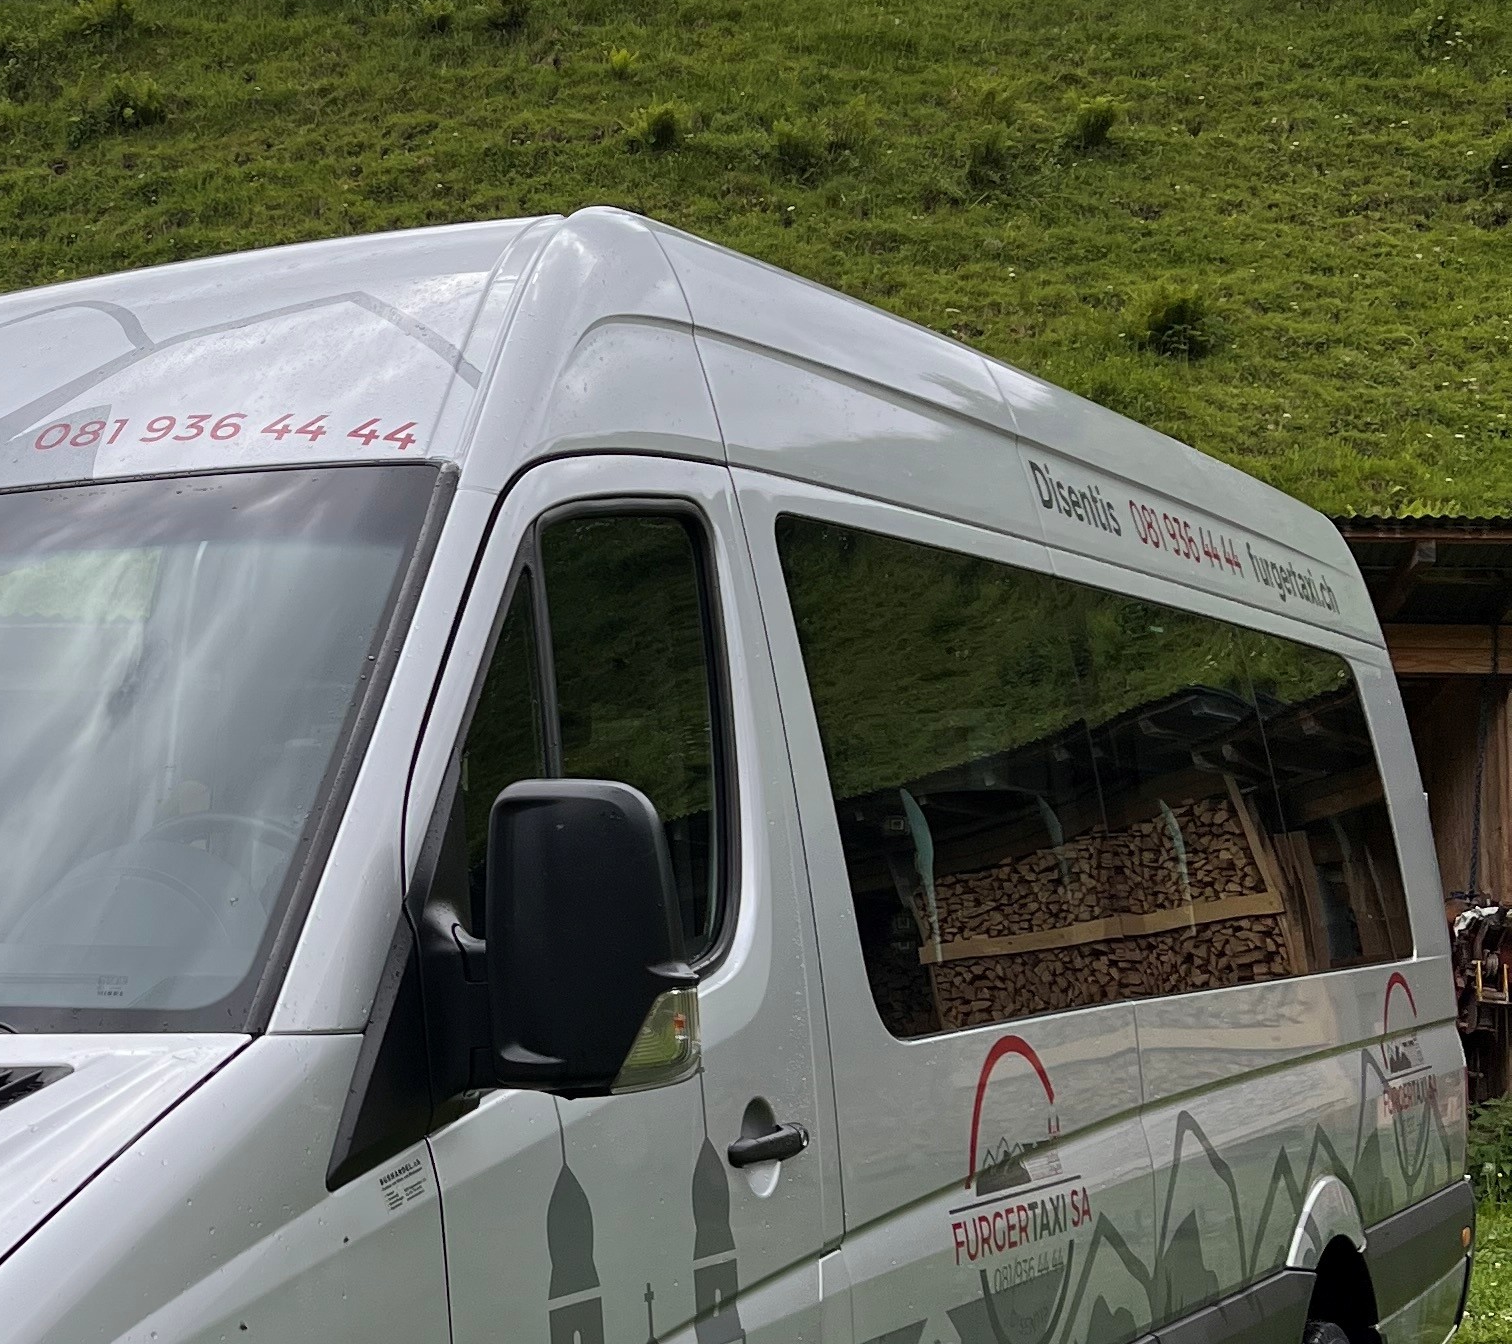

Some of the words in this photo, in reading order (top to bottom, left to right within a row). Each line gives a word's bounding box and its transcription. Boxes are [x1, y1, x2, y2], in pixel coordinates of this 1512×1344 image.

[33, 417, 130, 451] 081
[138, 412, 248, 444] 936
[260, 413, 330, 442] 44
[346, 417, 418, 451] 44
[1028, 460, 1122, 537] Disentis
[1129, 500, 1168, 552] 081
[1163, 513, 1201, 563] 936
[1199, 526, 1224, 571] 44
[1220, 535, 1245, 578] 44
[1070, 1186, 1093, 1227] SA
